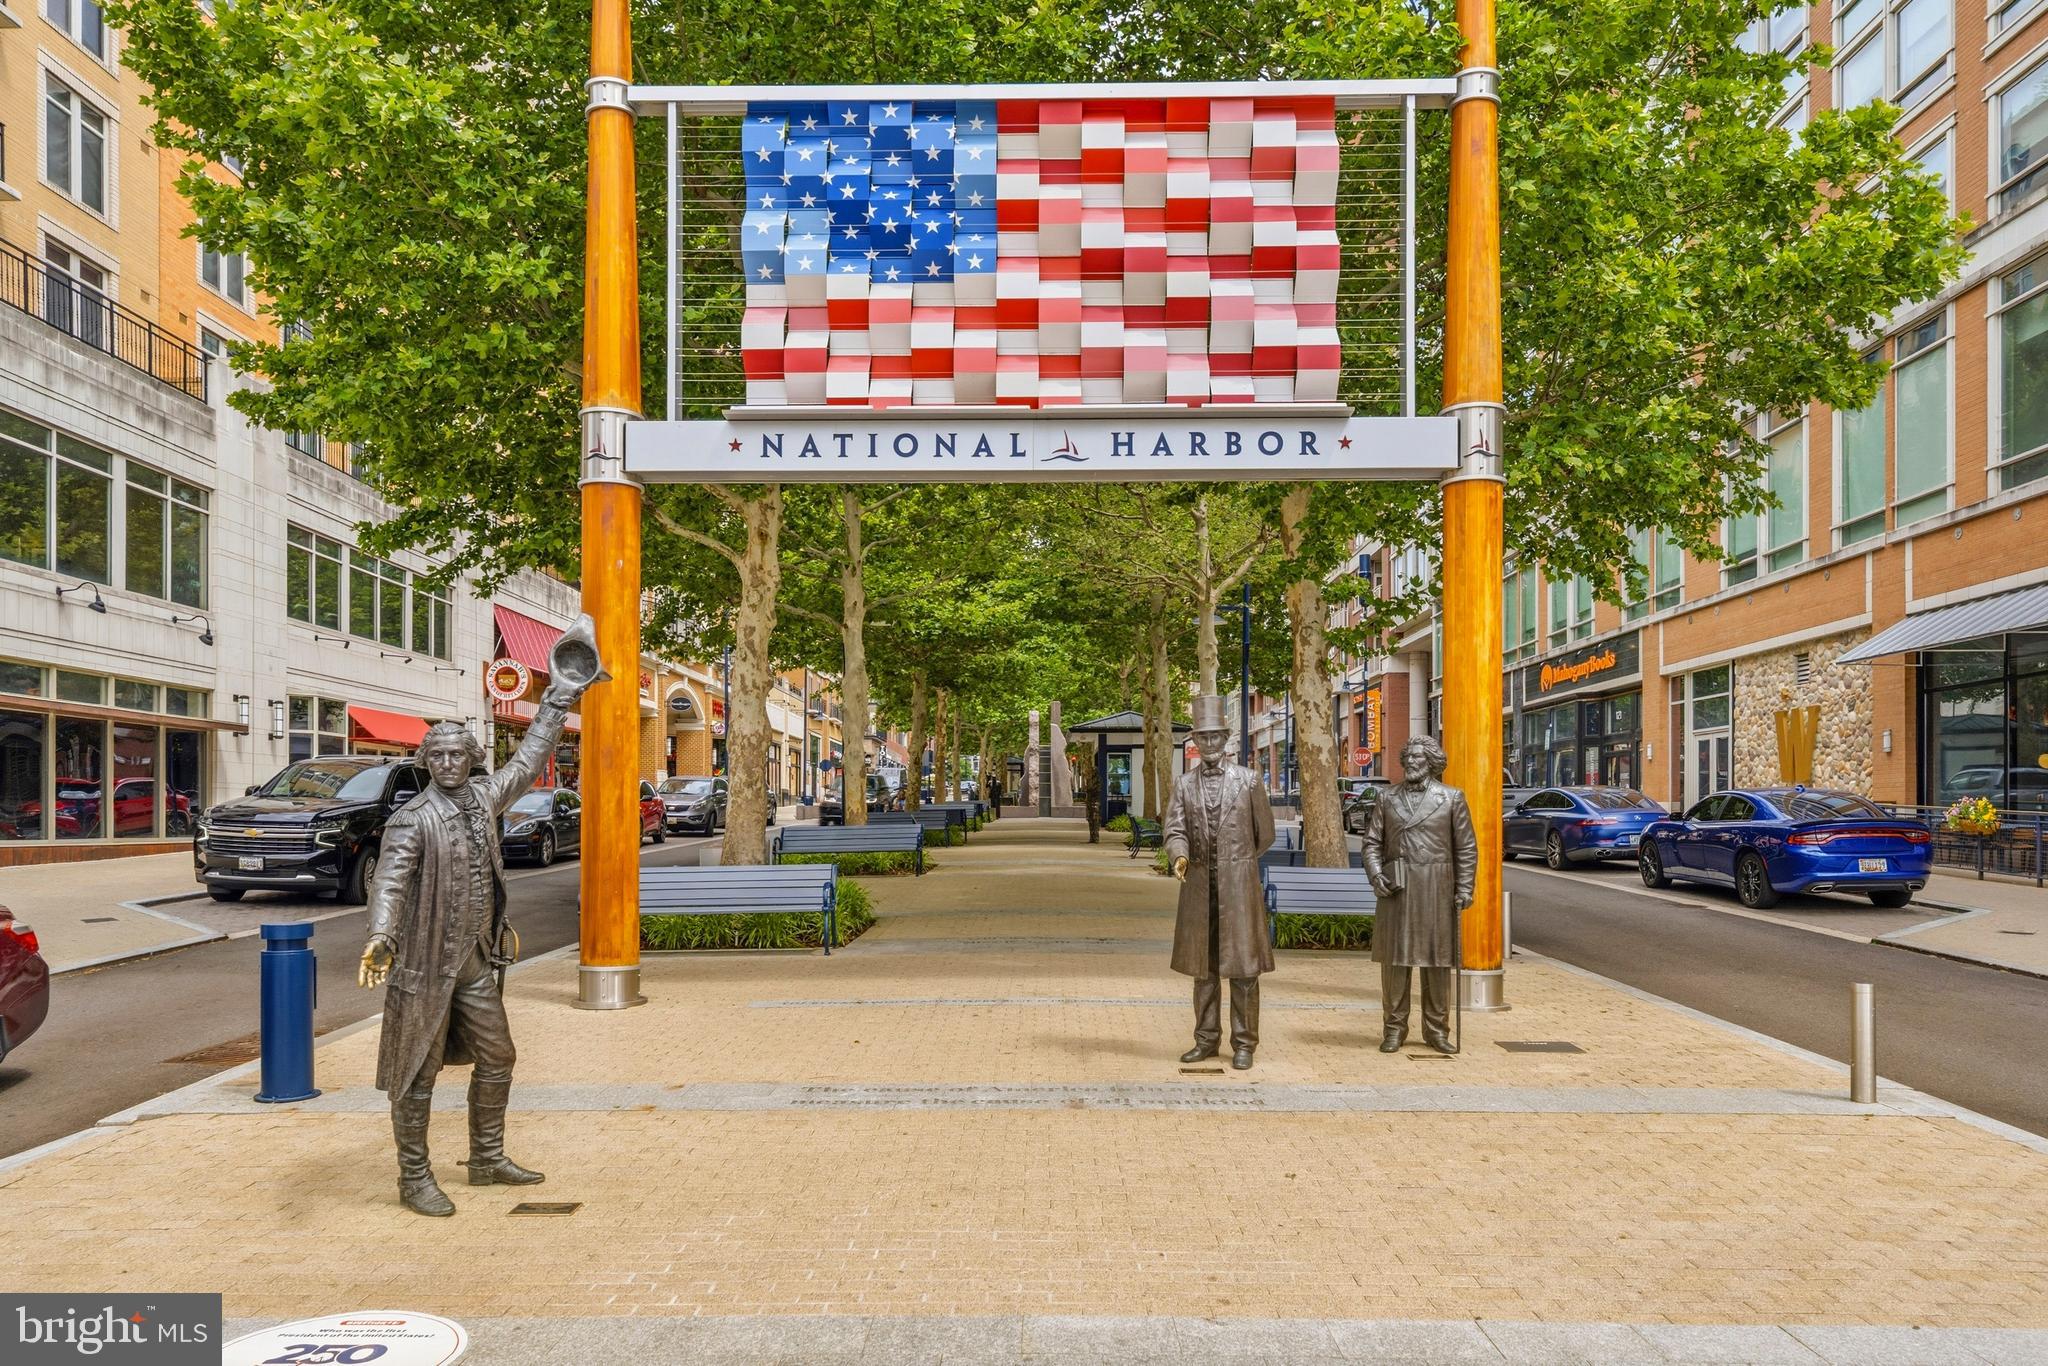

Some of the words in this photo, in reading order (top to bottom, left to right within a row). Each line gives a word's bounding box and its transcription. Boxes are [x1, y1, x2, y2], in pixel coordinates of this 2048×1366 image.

[760, 432, 1027, 458] NATIONAL
[1110, 430, 1321, 456] HARBOR
[1354, 753, 1370, 761] STOP
[262, 1343, 389, 1365] 250
